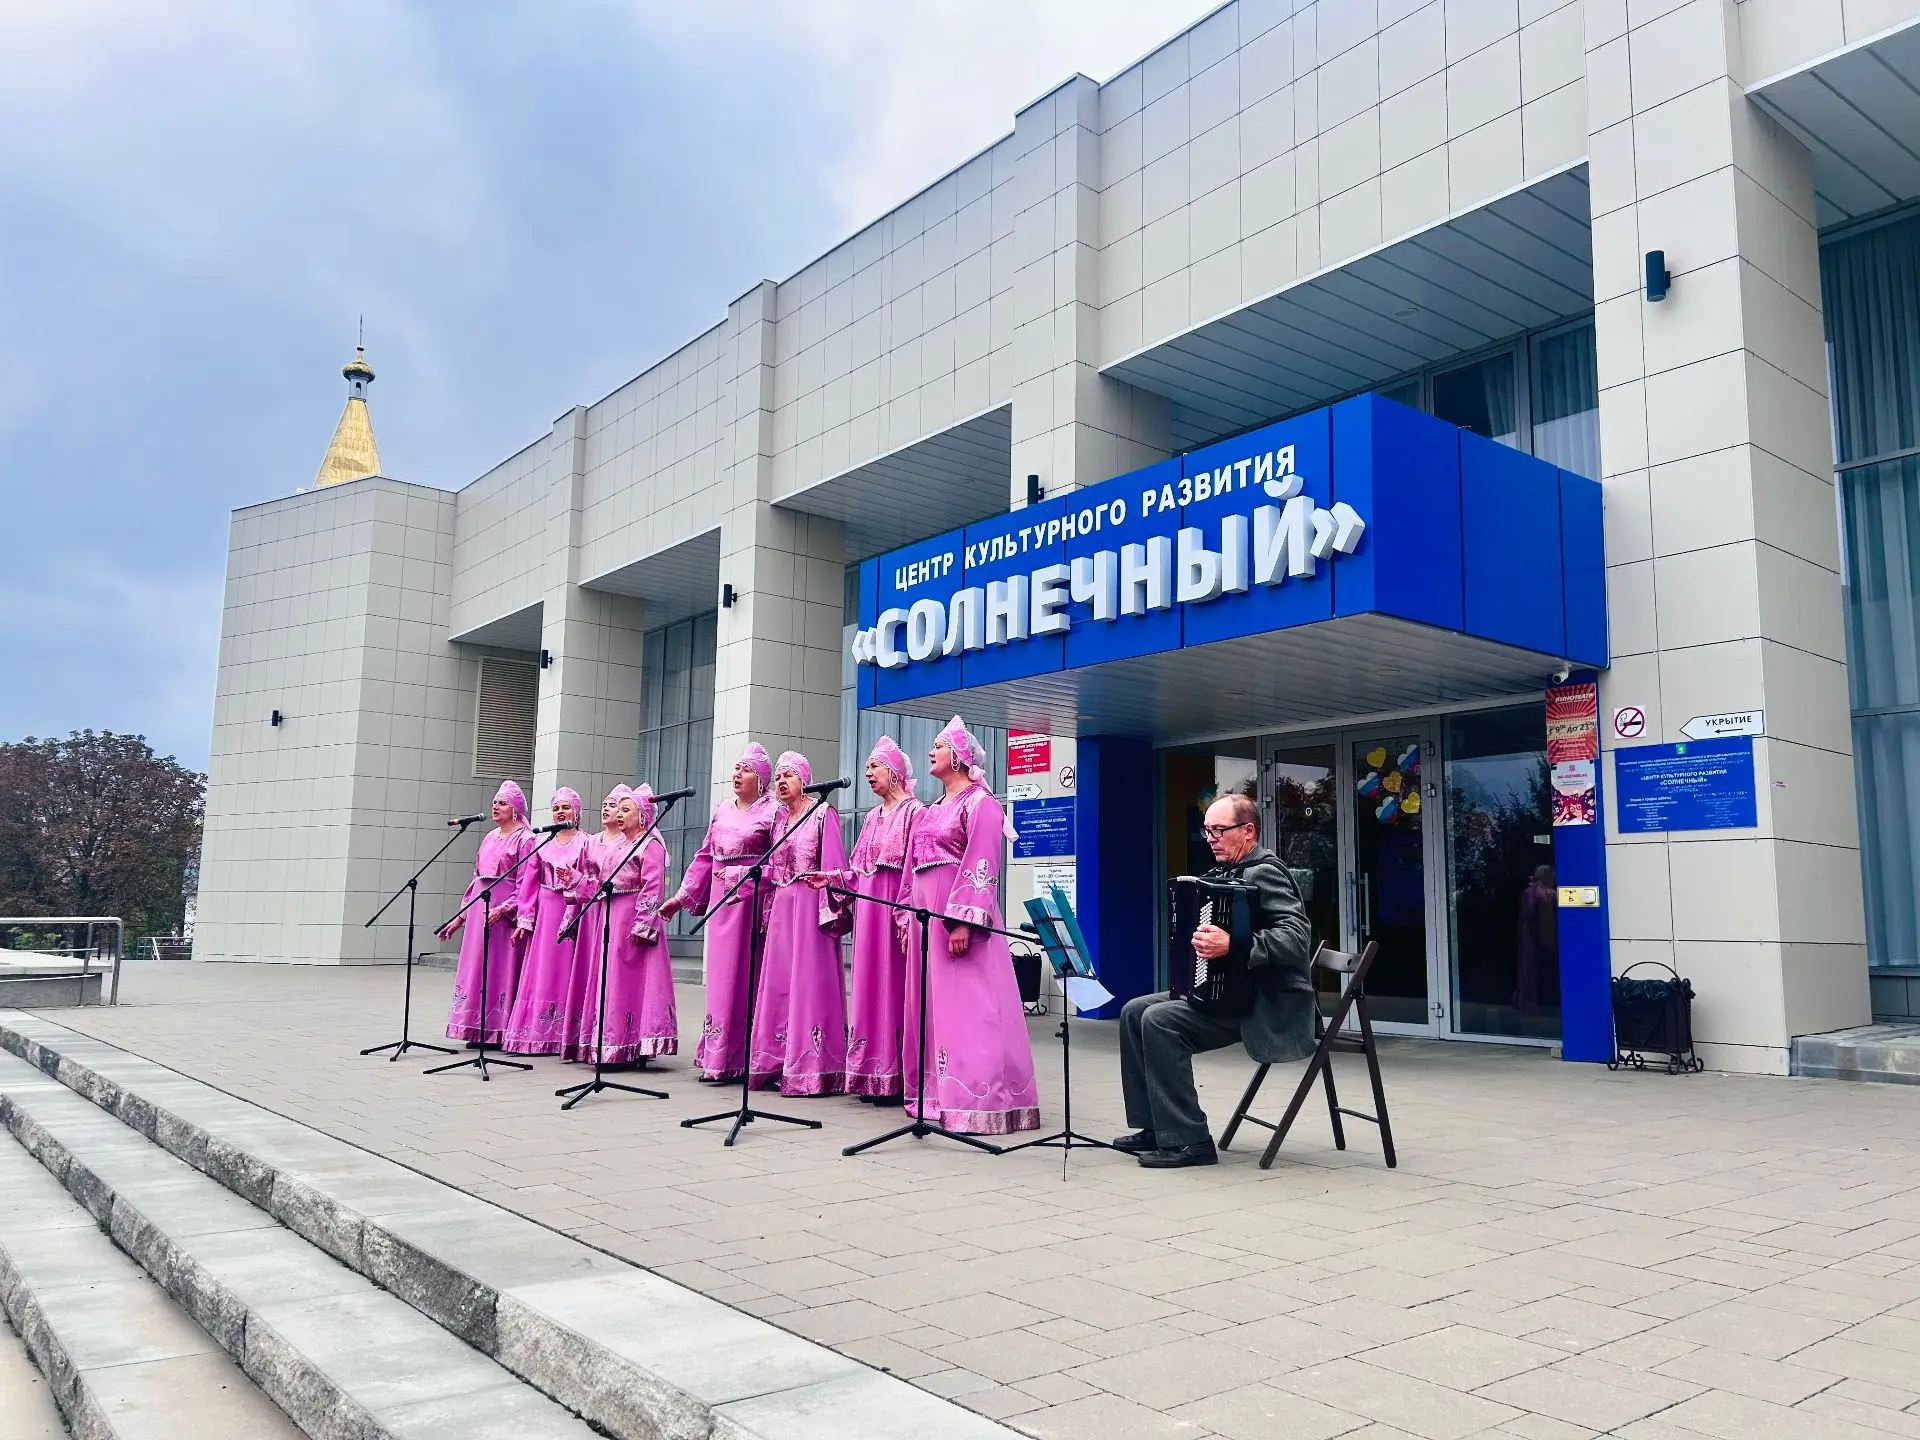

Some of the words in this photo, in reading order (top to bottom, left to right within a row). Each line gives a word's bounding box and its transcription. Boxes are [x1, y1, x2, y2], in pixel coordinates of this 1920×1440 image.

[895, 551, 954, 592] ЦЕНТР
[964, 498, 1127, 568] КУЛЬТУРНОГО
[1141, 443, 1296, 517] РАЗВИТИЯ
[850, 474, 1366, 669] «СОЛНЕЧНЫЙ»
[1555, 692, 1594, 703] КИНОТЕАТР
[1705, 715, 1752, 727] УКРЫТИЕ
[1567, 726, 1578, 734] до
[1660, 771, 1698, 779] КУЛЬТУРНОГО
[1698, 768, 1728, 776] РАЗВИТИЯ
[1660, 776, 1708, 786] «СОЛНЕЧНЫЙ»
